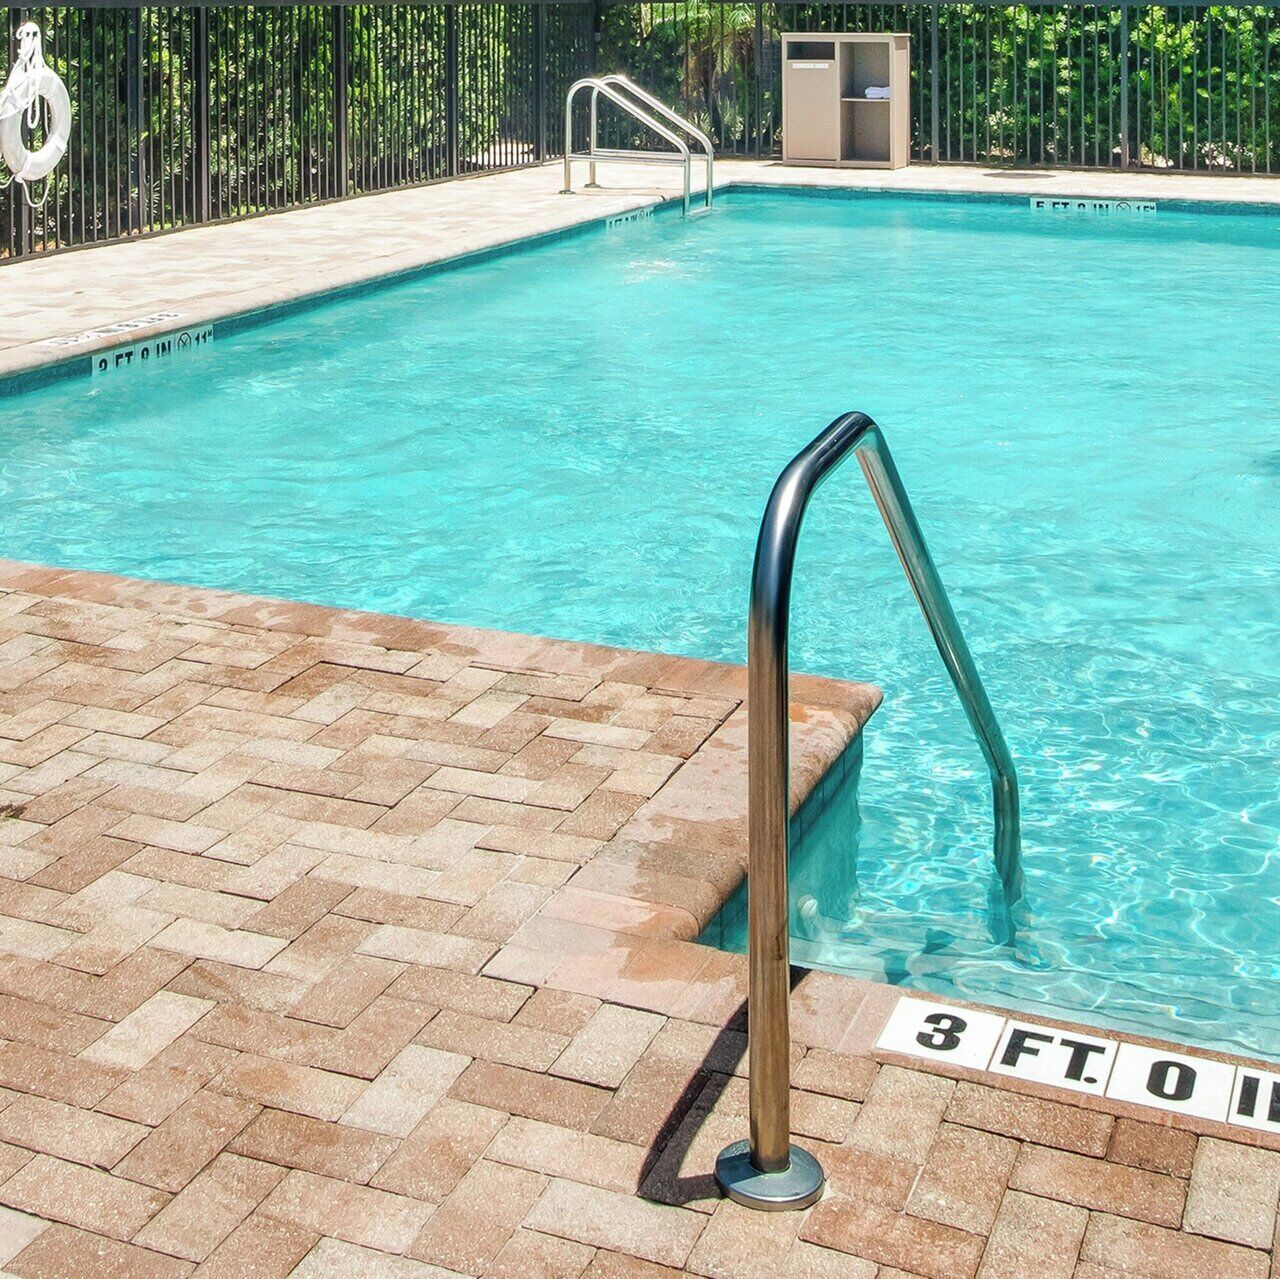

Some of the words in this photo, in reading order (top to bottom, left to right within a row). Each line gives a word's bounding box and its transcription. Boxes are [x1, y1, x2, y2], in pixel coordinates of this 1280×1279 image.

[916, 1013, 968, 1051] 3
[999, 1028, 1107, 1084] FT.
[1146, 1060, 1198, 1101] 0
